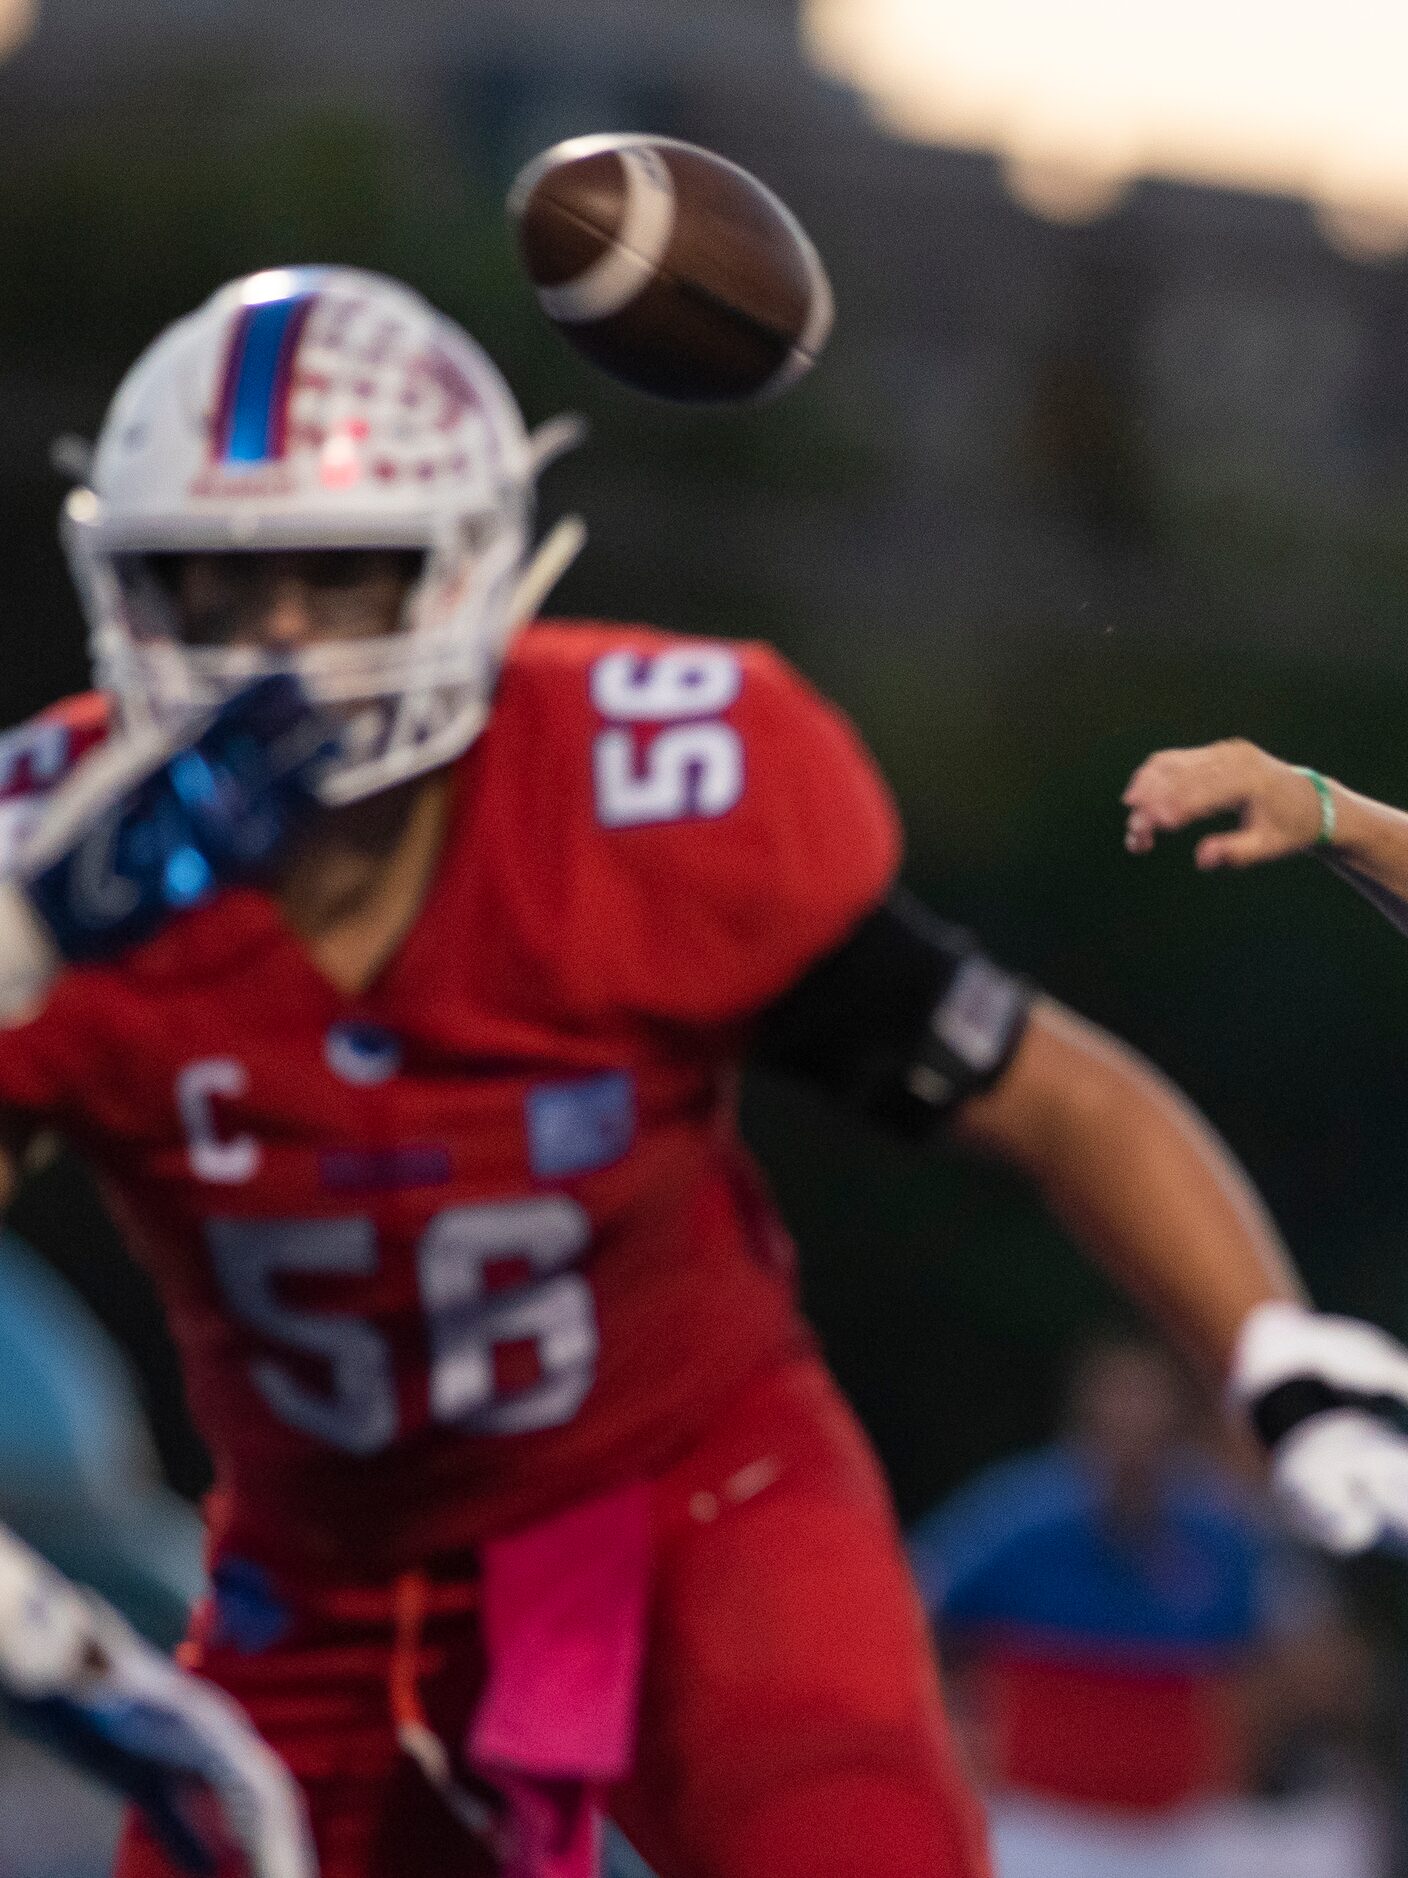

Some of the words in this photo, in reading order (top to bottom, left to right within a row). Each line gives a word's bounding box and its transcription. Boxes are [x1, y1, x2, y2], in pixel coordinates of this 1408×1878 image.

[590, 644, 747, 828] 56
[174, 1056, 260, 1184] C
[205, 1195, 600, 1456] 56
